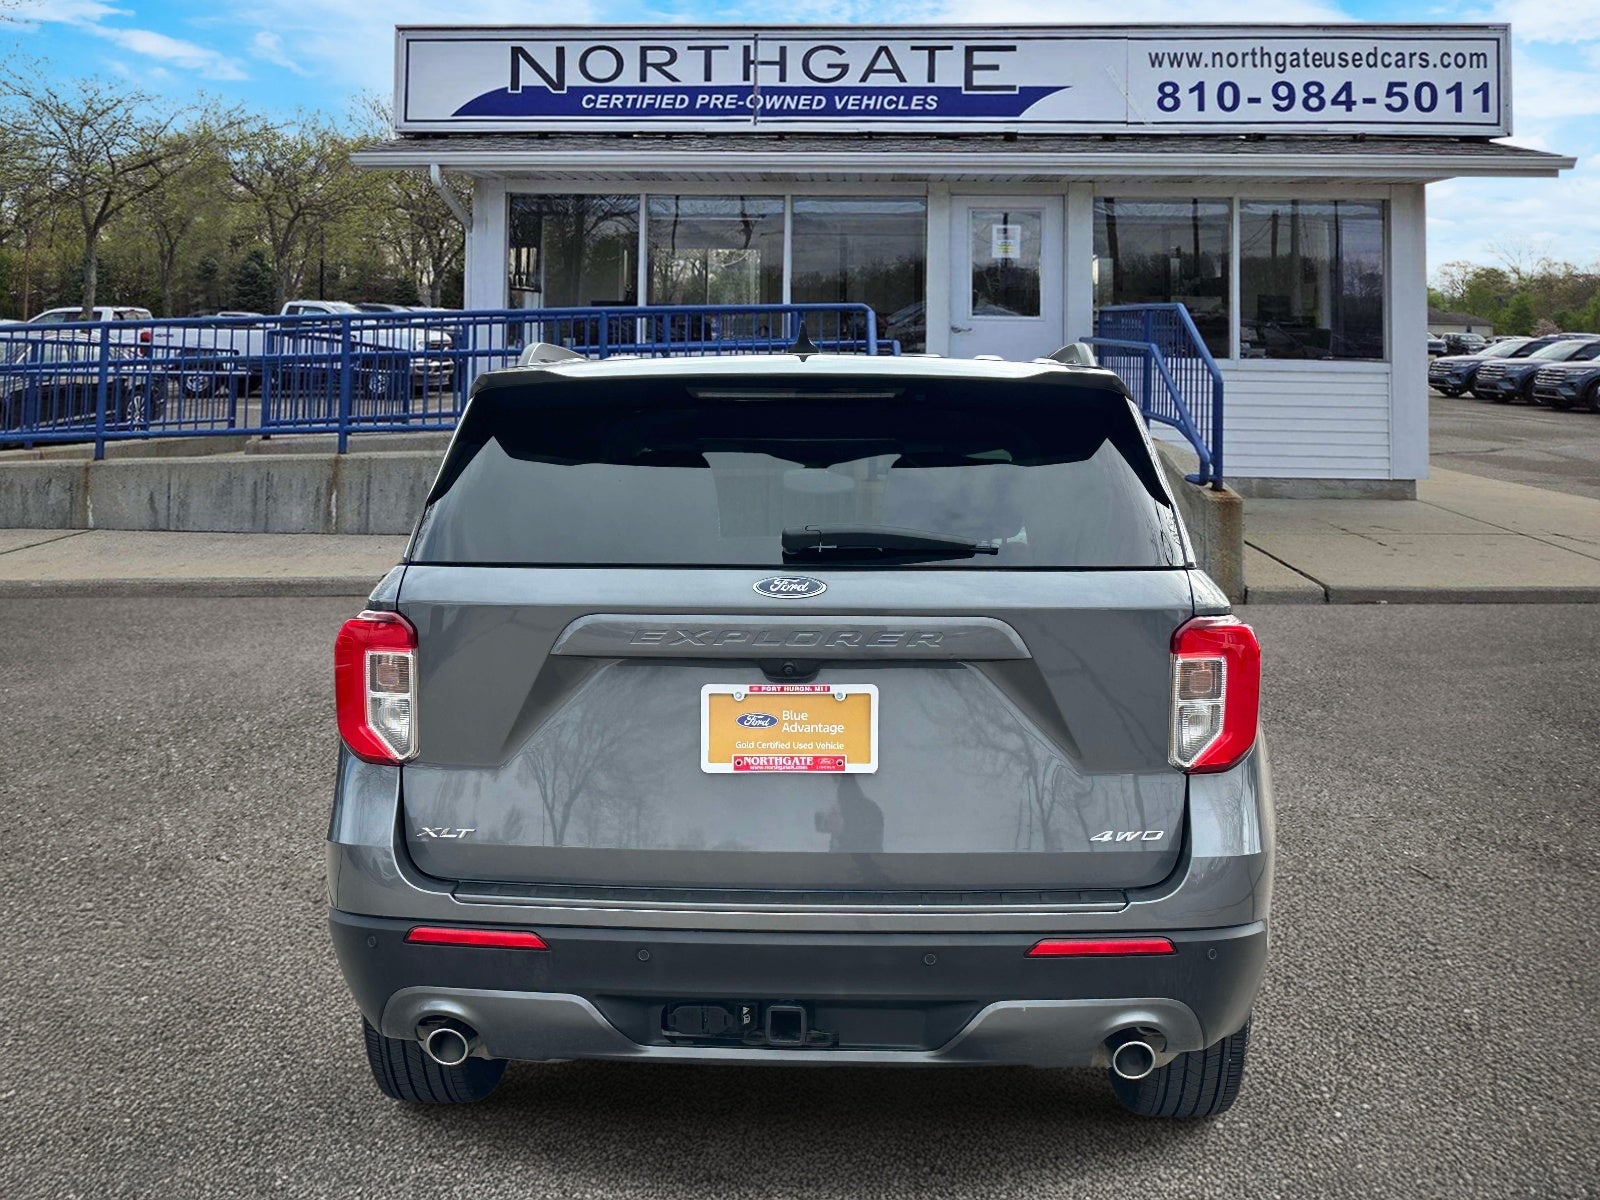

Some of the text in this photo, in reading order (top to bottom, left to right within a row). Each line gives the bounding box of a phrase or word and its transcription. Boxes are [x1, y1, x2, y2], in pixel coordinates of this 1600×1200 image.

[1148, 46, 1489, 73] www.northgateusedcars.com
[508, 45, 1018, 93] NORTHGATE
[581, 94, 939, 111] CERTIFIED PRE-OWNED VEHICLES
[1156, 80, 1491, 114] 810-984-5011
[629, 629, 945, 648] EXPLORER
[782, 710, 809, 721] Blue
[781, 722, 845, 735] Advantage
[735, 741, 845, 750] Gold Certified Used Vehicle
[743, 756, 814, 766] NORTHGATE
[416, 826, 477, 839] XLT
[1089, 830, 1165, 843] 4WD
